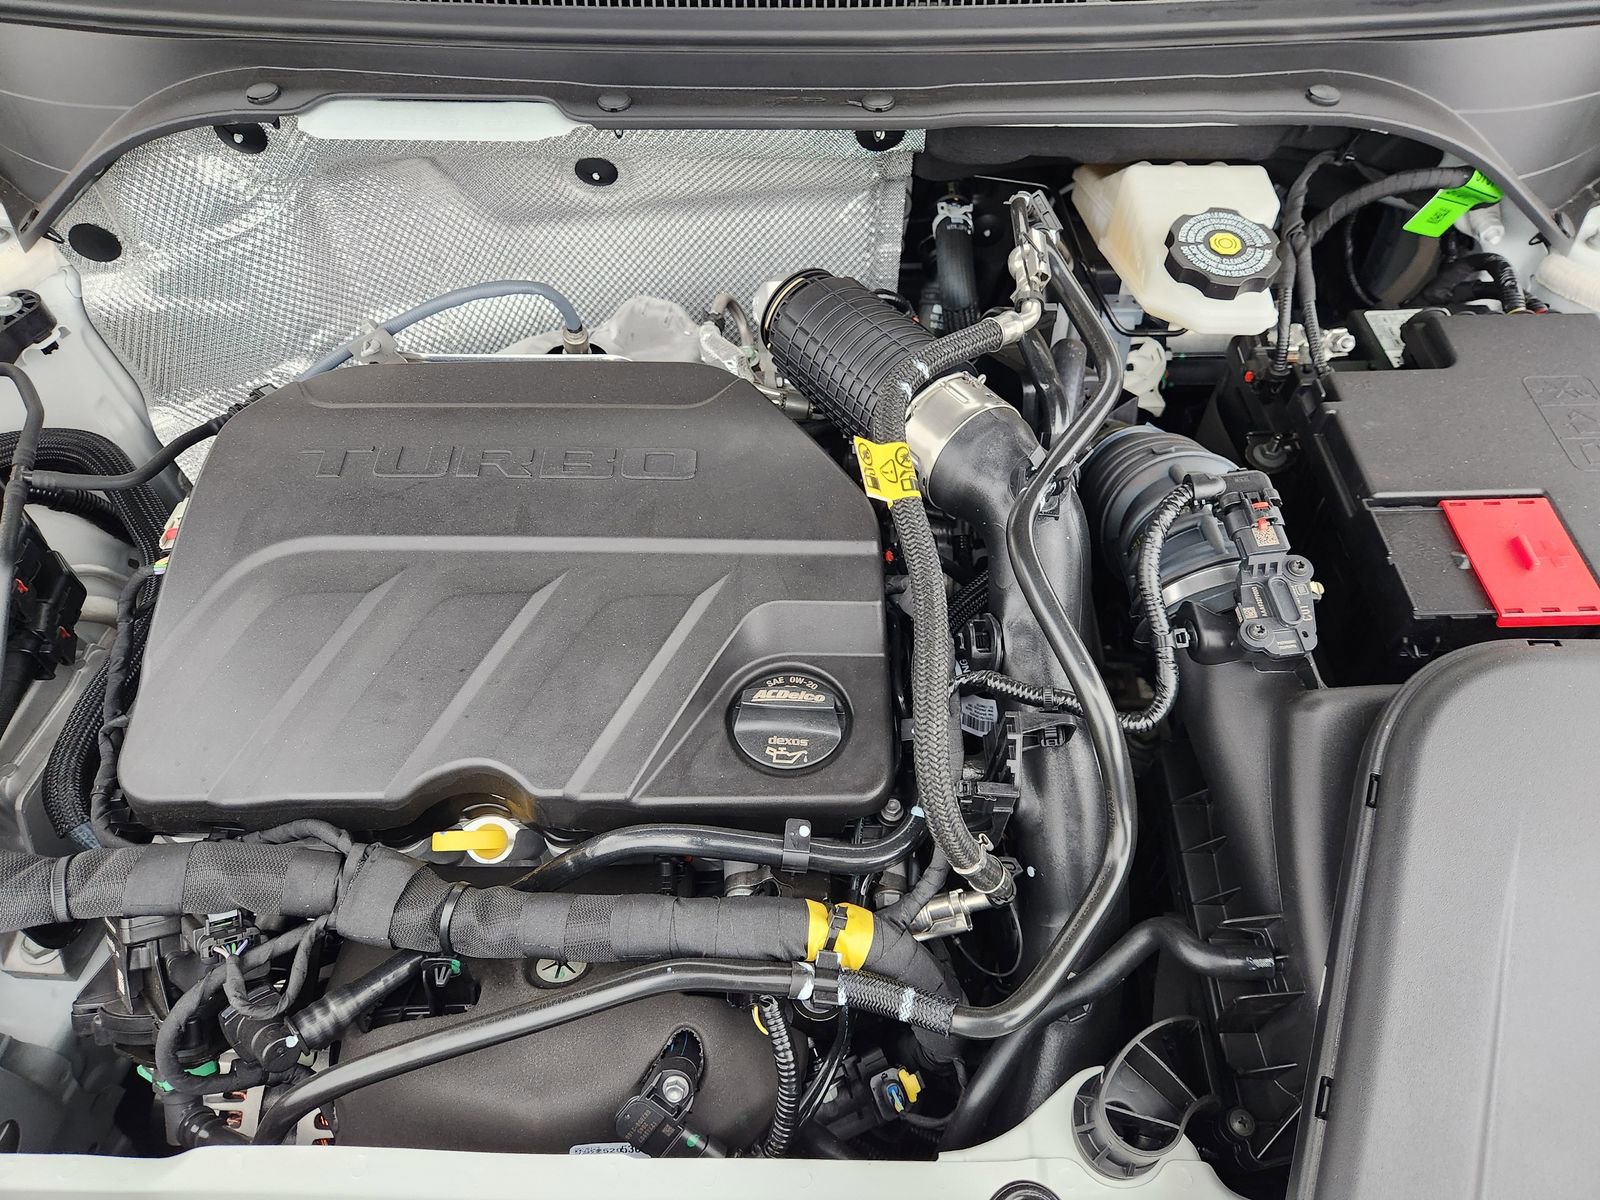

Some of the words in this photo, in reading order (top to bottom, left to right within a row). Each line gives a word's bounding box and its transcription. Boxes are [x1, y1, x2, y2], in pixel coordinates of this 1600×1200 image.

[299, 445, 699, 481] TURBO
[766, 676, 784, 687] SAE
[789, 676, 818, 690] 0W-20
[751, 689, 826, 702] ACDelco
[768, 736, 809, 746] dexos
